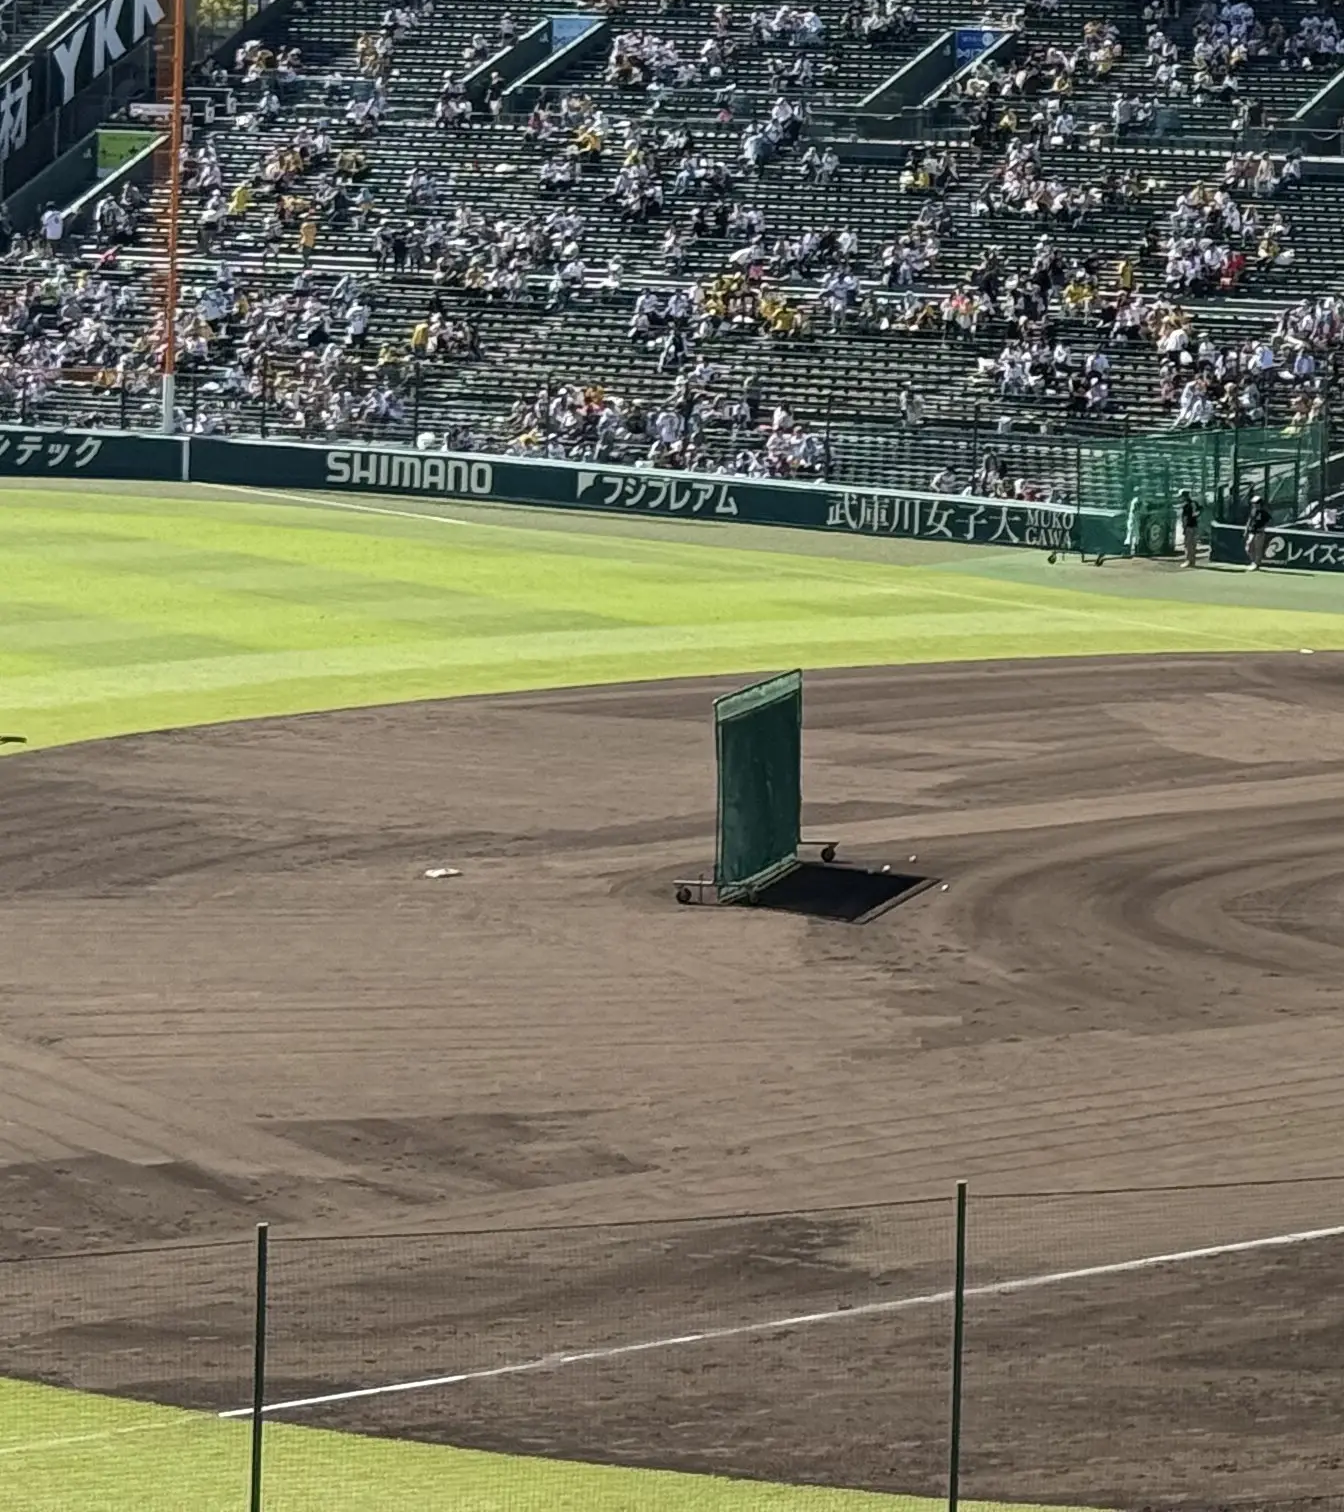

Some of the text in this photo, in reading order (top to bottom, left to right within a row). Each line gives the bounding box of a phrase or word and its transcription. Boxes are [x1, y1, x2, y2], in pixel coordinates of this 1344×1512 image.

[326, 451, 492, 495] SHIMANO
[601, 475, 739, 516] フジプレアム
[825, 492, 1020, 545] 武庫川女子大
[1025, 527, 1073, 549] GAWA
[1026, 508, 1075, 529] MUKO
